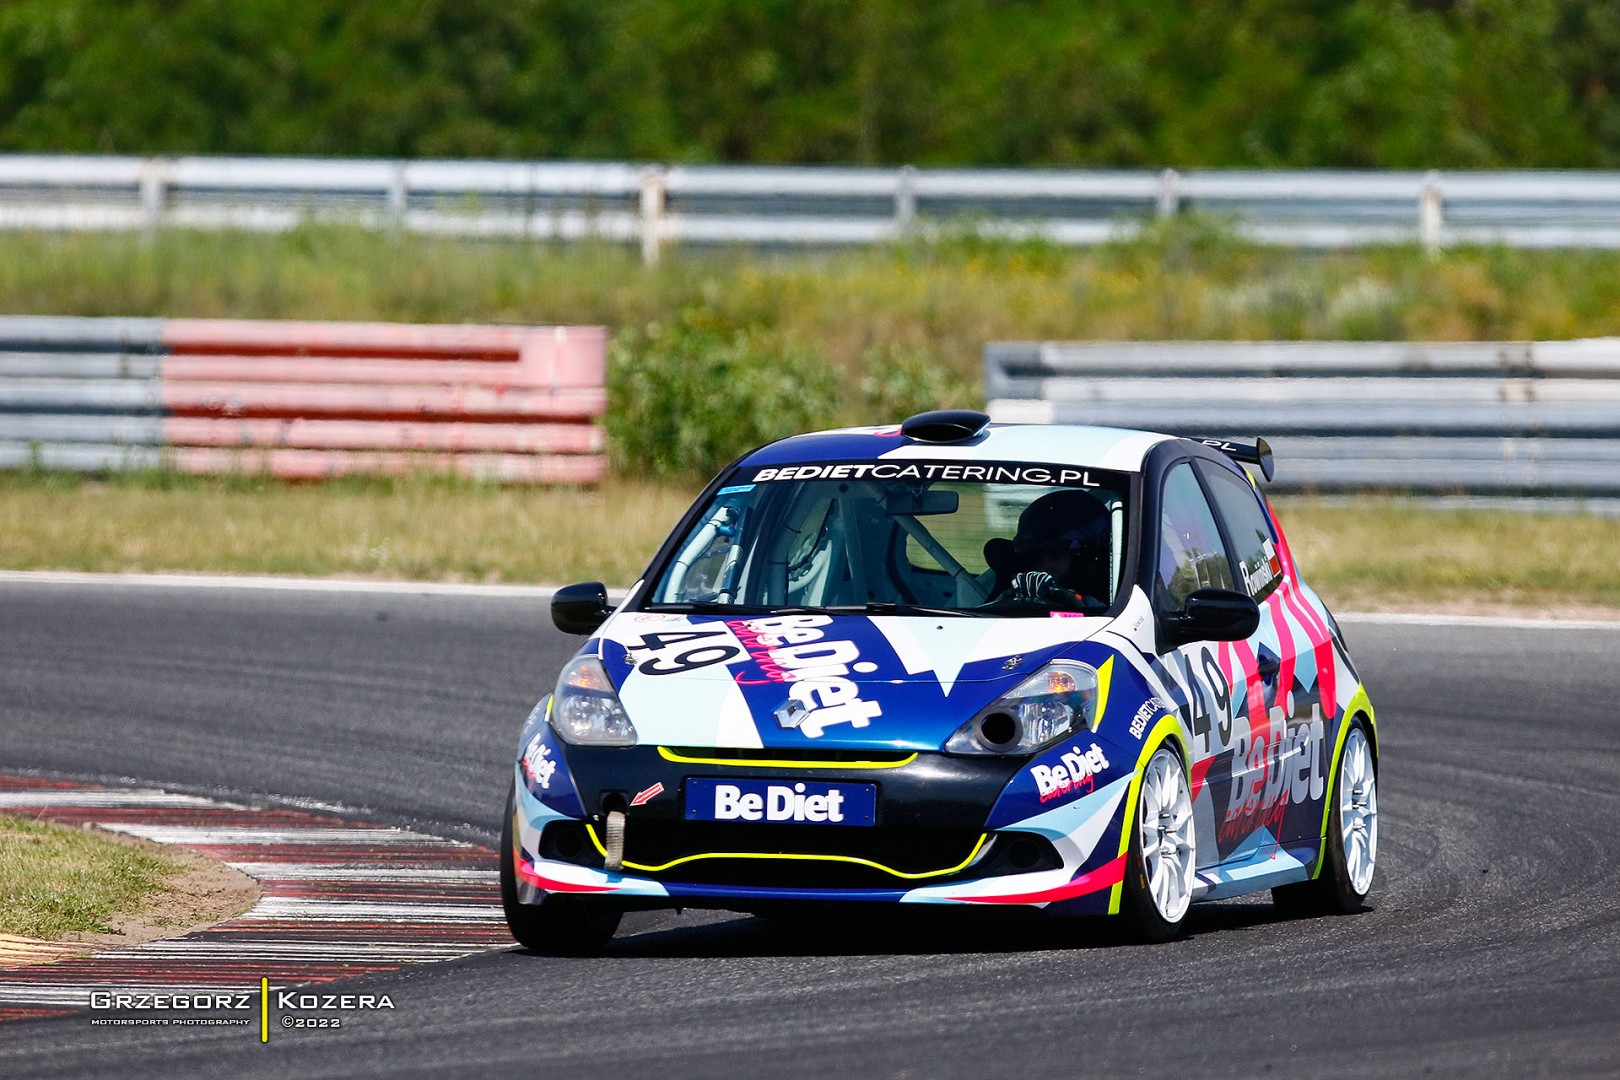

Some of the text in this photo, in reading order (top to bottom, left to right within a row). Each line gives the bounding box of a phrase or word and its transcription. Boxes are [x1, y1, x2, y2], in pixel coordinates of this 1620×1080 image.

[752, 464, 1101, 487] BEDIETCATERING.PL
[627, 630, 741, 676] 49
[767, 640, 883, 739] Diet
[1184, 646, 1233, 753] 49
[1030, 742, 1110, 797] Be Diet
[714, 782, 844, 823] Be Diet
